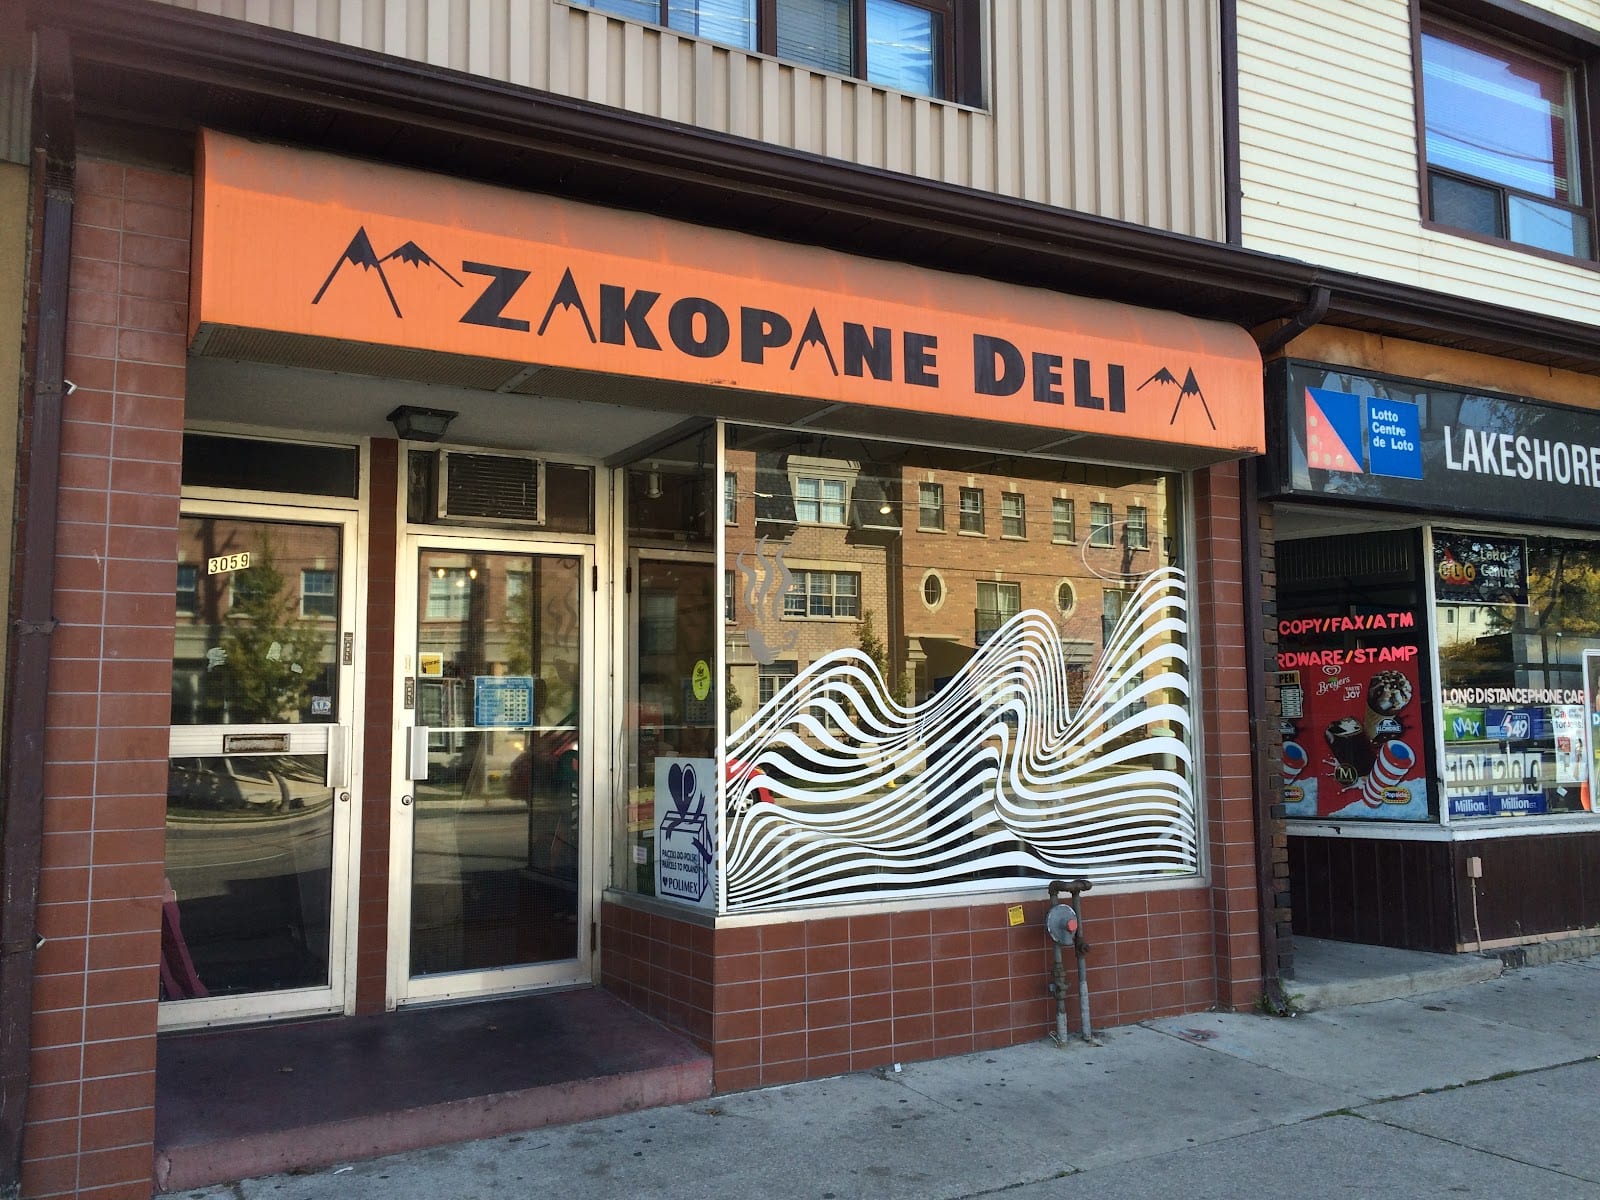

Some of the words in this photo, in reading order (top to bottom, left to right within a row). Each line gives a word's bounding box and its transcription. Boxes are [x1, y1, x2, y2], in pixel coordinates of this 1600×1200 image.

[459, 260, 939, 389] ZAKOPANE
[973, 333, 1126, 413] DELI
[1371, 407, 1399, 422] Lotto
[1371, 421, 1407, 437] Centre
[1372, 435, 1386, 448] de
[1391, 437, 1414, 452] Loto
[1443, 425, 1600, 488] LAKESHORE
[210, 553, 249, 573] 3059
[1278, 612, 1414, 635] COPY/FAX/ATM
[1277, 645, 1418, 669] RDWARE/STAMP
[1279, 673, 1295, 684] PEN
[1316, 676, 1351, 696] Breyers
[1345, 691, 1361, 699] JOY
[1443, 687, 1475, 704] LONG
[1564, 689, 1585, 705] CAR
[1454, 798, 1485, 813] Million
[1500, 795, 1530, 810] Million
[668, 877, 698, 894] POLIMEX
